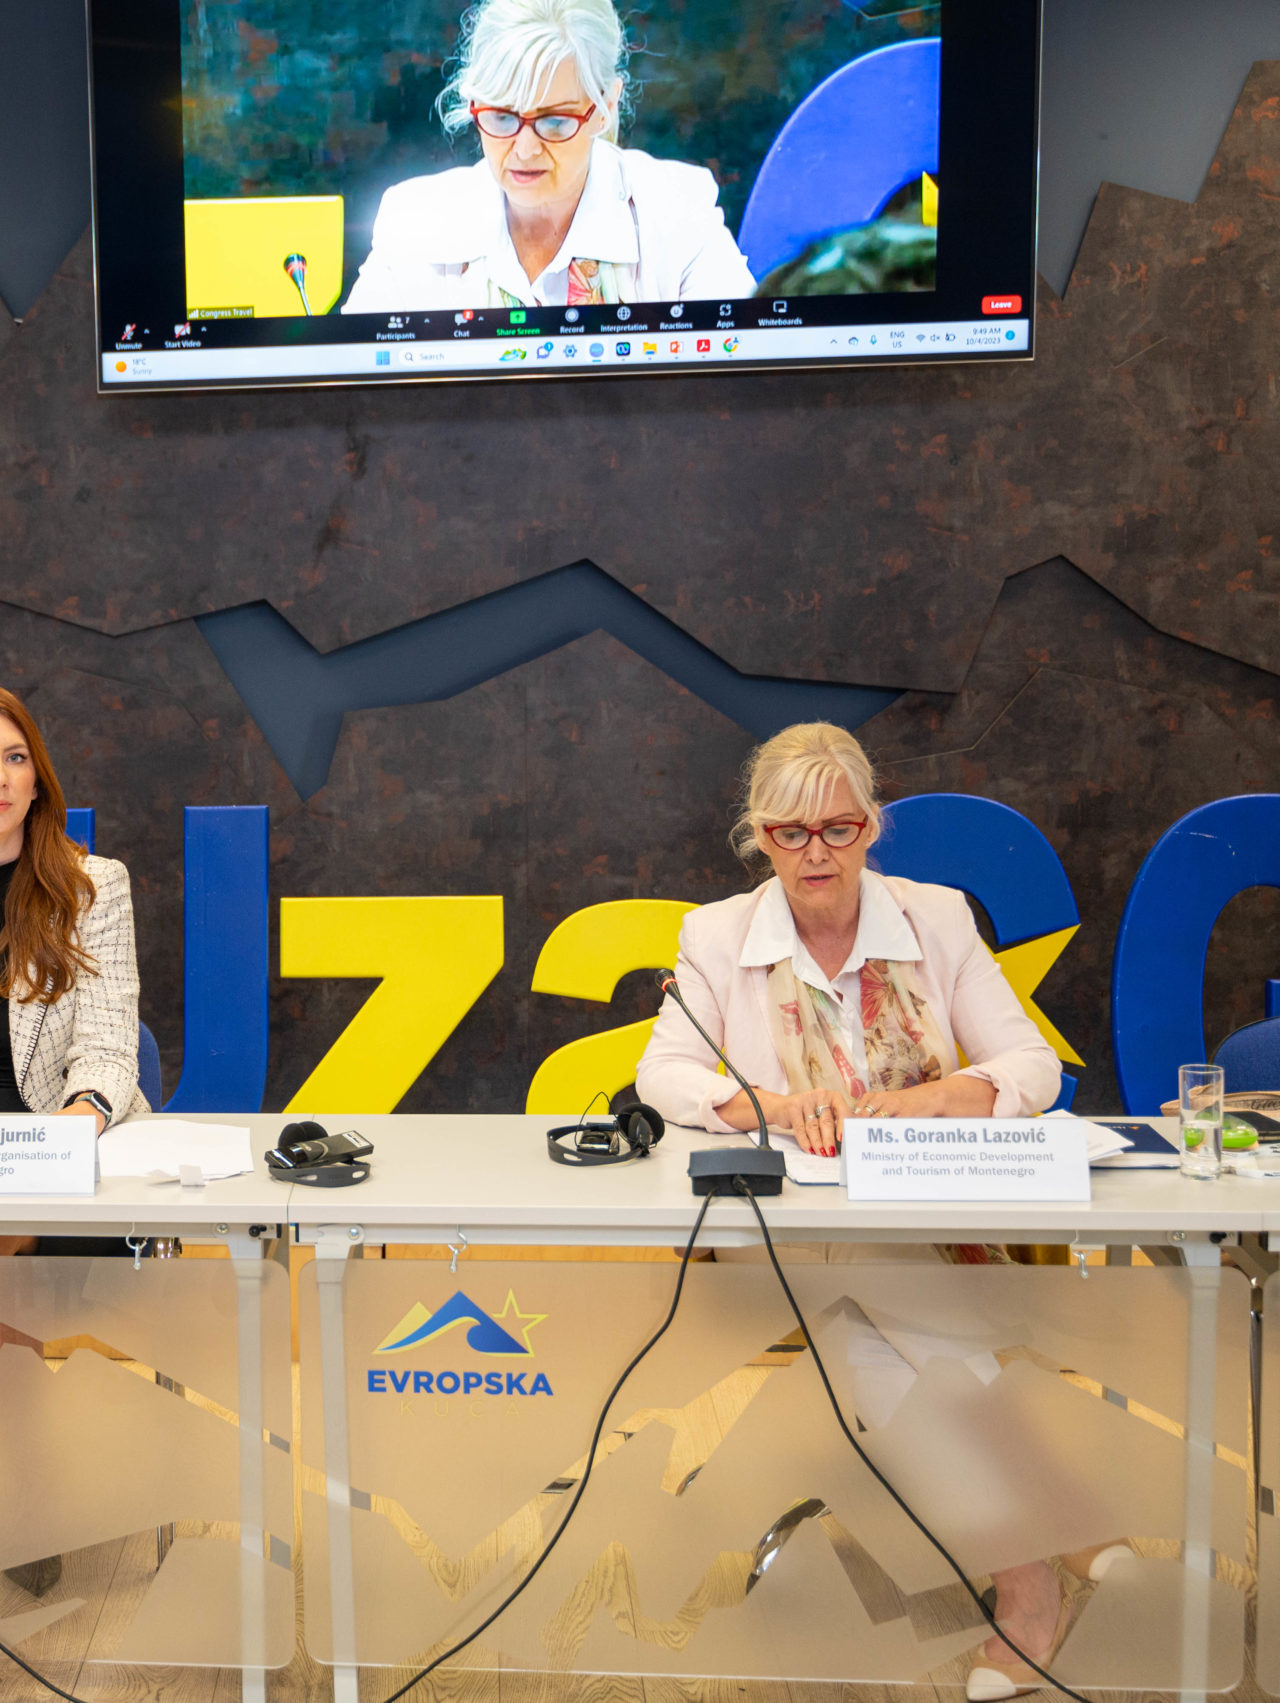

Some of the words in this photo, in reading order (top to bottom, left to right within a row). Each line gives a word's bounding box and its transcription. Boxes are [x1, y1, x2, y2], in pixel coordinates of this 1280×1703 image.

[991, 301, 1012, 309] Leave
[200, 308, 231, 319] Congress
[233, 307, 253, 317] Travel
[659, 321, 693, 330] Reactions
[716, 320, 735, 329] Apps
[758, 317, 803, 327] Whiteboards
[496, 328, 515, 336] Share
[517, 327, 540, 335] Screen
[560, 325, 584, 334] Record
[600, 323, 648, 332] Interpretation
[988, 327, 1001, 335] AM
[376, 332, 416, 342] Participants
[453, 329, 470, 338] Chat
[890, 331, 905, 339] ENG
[164, 340, 180, 349] Start
[182, 339, 201, 348] Video
[966, 336, 1001, 346] 10/4/2023
[115, 342, 142, 350] Unmute
[419, 352, 445, 360] Search
[132, 367, 152, 376] Sunny
[867, 1128, 899, 1143] Ms.
[904, 1128, 977, 1143] Goranka
[982, 1126, 1046, 1143] Lazović
[60, 1150, 72, 1160] of
[861, 1151, 905, 1164] Ministry
[908, 1151, 919, 1161] of
[922, 1151, 977, 1162] Economic
[979, 1152, 1054, 1164] Development
[881, 1166, 903, 1176] and
[906, 1166, 951, 1176] Tourism
[953, 1166, 965, 1176] of
[967, 1166, 1035, 1178] Montenegro
[367, 1369, 554, 1396] EVROPSKA
